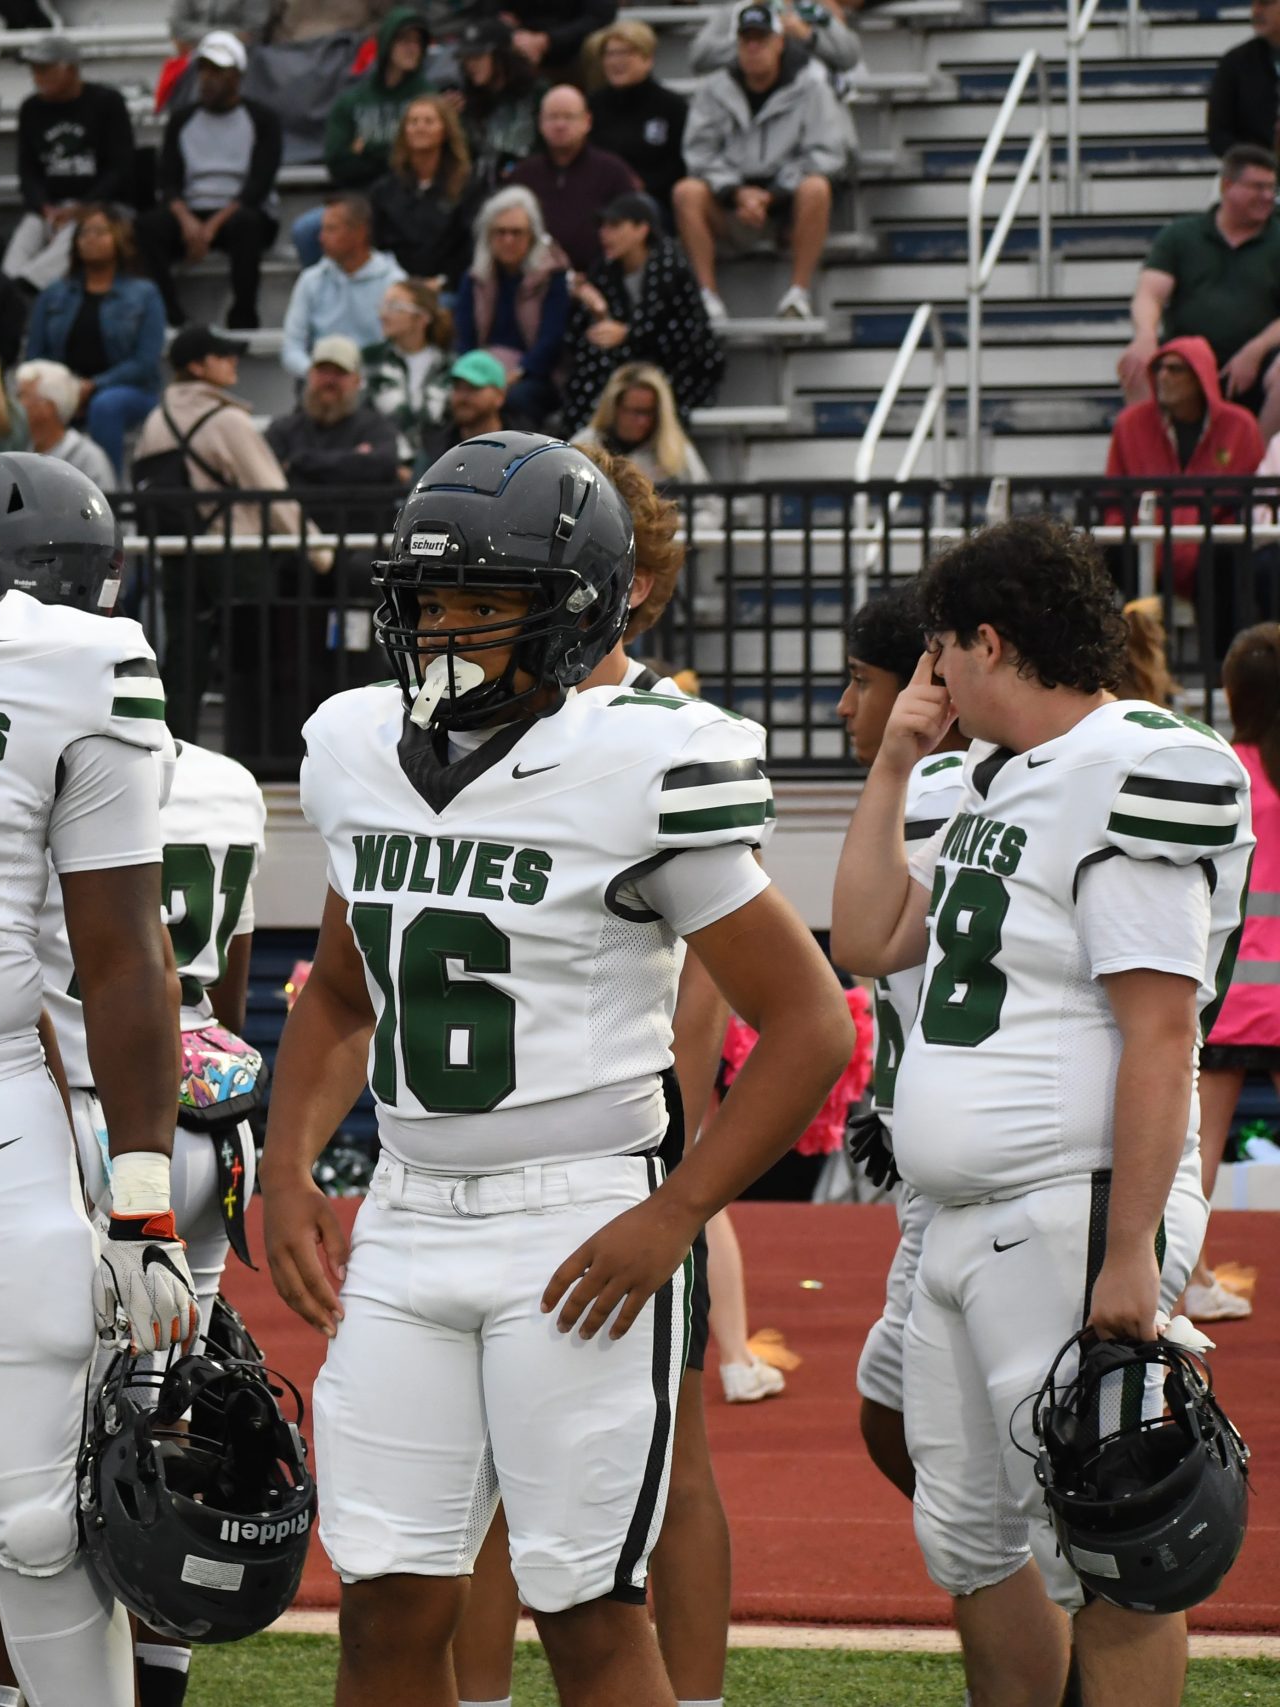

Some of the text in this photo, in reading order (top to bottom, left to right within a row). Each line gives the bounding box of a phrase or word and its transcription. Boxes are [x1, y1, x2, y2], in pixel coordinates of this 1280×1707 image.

[411, 537, 446, 552] schutt
[352, 835, 553, 905] WOLVES
[351, 901, 517, 1113] 16
[220, 1509, 309, 1545] Riddell
